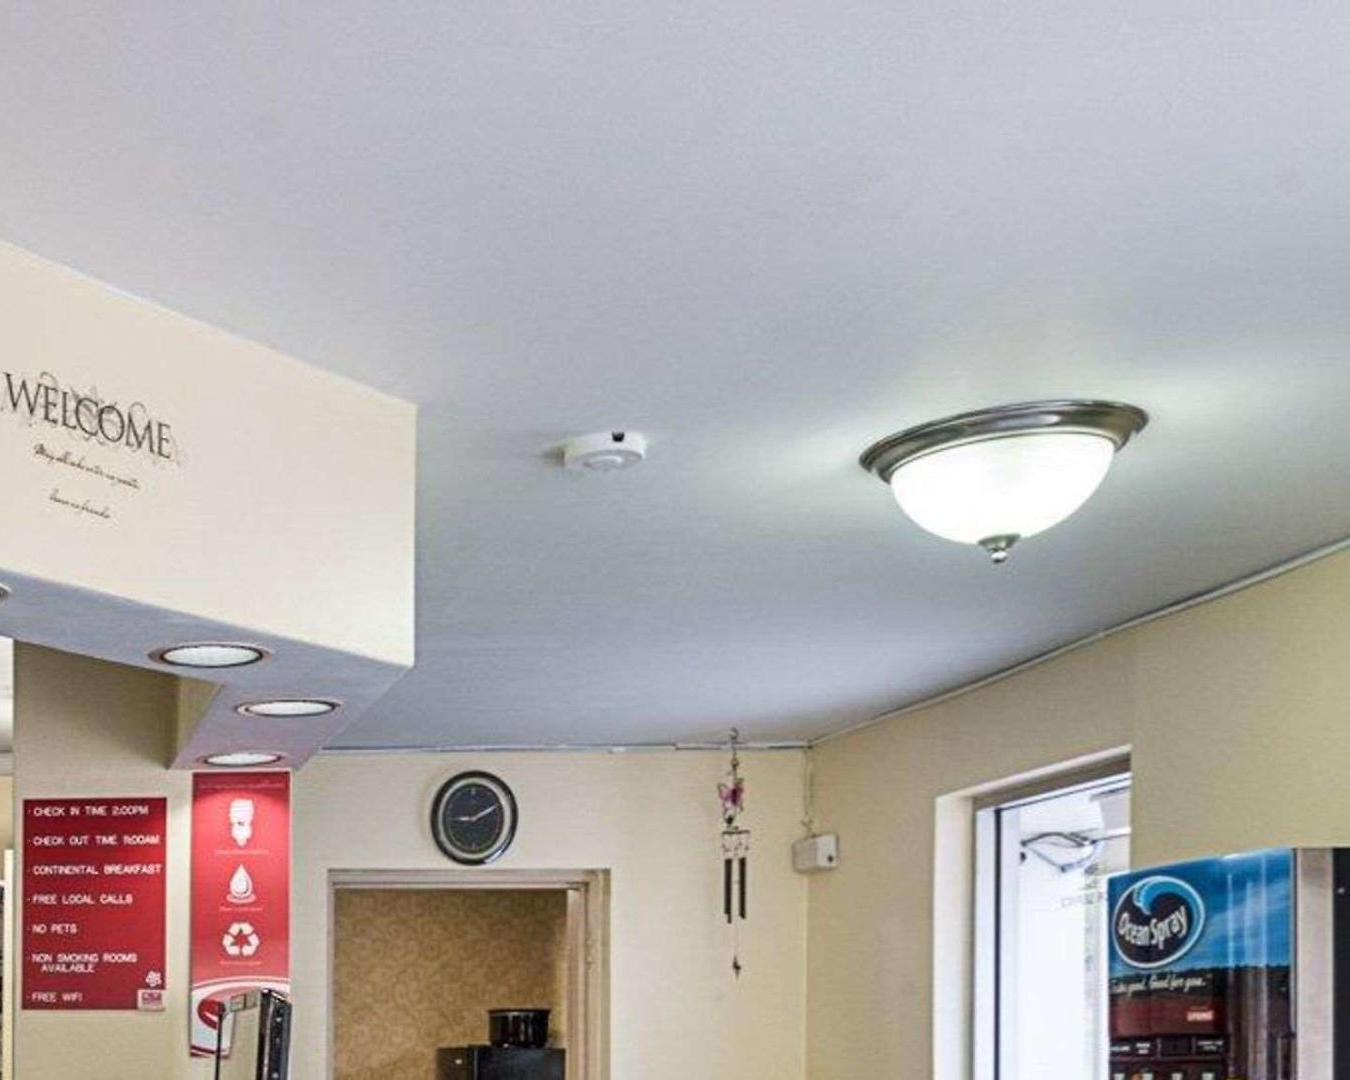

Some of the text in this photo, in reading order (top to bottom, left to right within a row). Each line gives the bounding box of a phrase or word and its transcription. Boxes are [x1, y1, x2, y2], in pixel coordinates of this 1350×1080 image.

[3, 371, 171, 459] WELCOME
[33, 806, 65, 816] CHECK
[70, 805, 80, 815] IN
[85, 805, 107, 816] TIME
[33, 835, 65, 846] CHECK
[69, 835, 88, 845] OUT
[95, 835, 117, 845] TIME
[33, 864, 162, 875] CONTINENTAL BREAKFAST
[33, 893, 133, 905] FREE LOCAL CALLS
[32, 923, 77, 934] NO PETS
[1118, 905, 1188, 950] Ocean Spray
[32, 952, 137, 963] NON SMOKING ROOMS
[41, 963, 94, 973] AVAILABLE
[32, 991, 57, 1002] FREE
